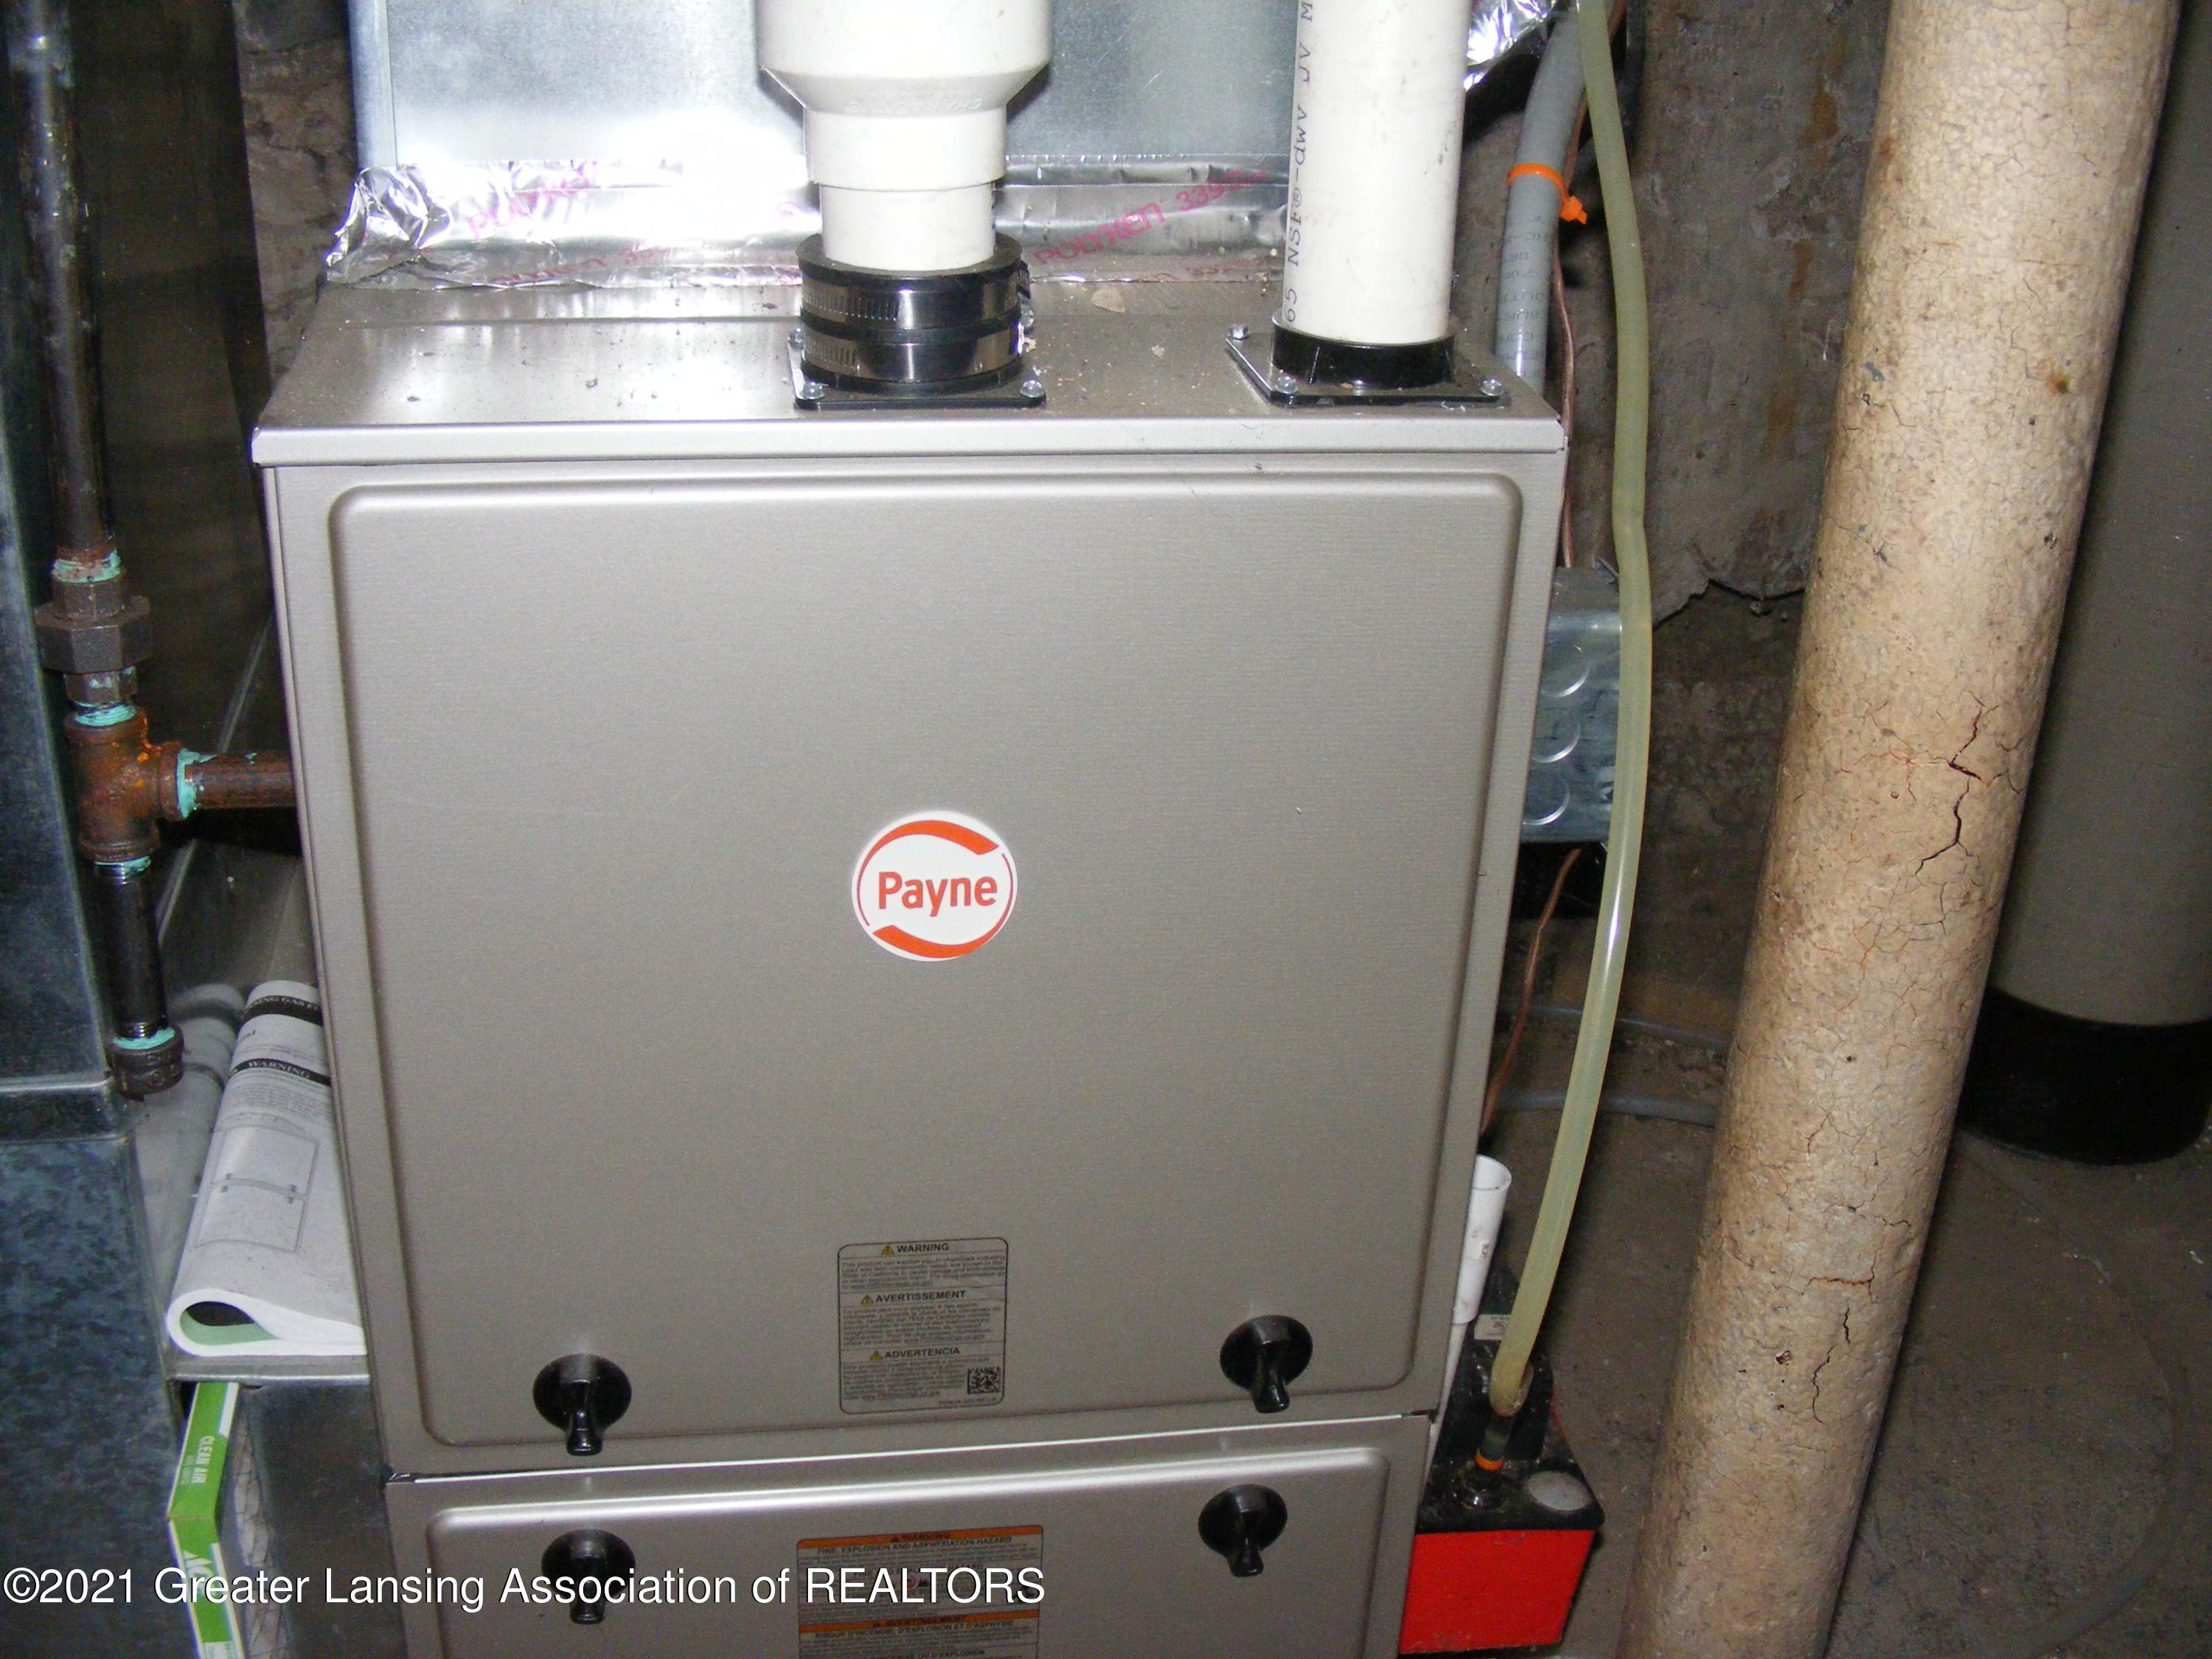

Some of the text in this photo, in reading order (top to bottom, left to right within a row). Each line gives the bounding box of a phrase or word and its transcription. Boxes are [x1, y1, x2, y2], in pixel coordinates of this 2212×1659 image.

[878, 871, 998, 917] Payne
[248, 1061, 310, 1078] WARNING
[897, 1242, 950, 1253] WARNING
[875, 1290, 966, 1303] AVERTISSEMENT
[885, 1347, 960, 1359] ADVERTENCIA
[191, 1436, 215, 1484] CLEAN AIR
